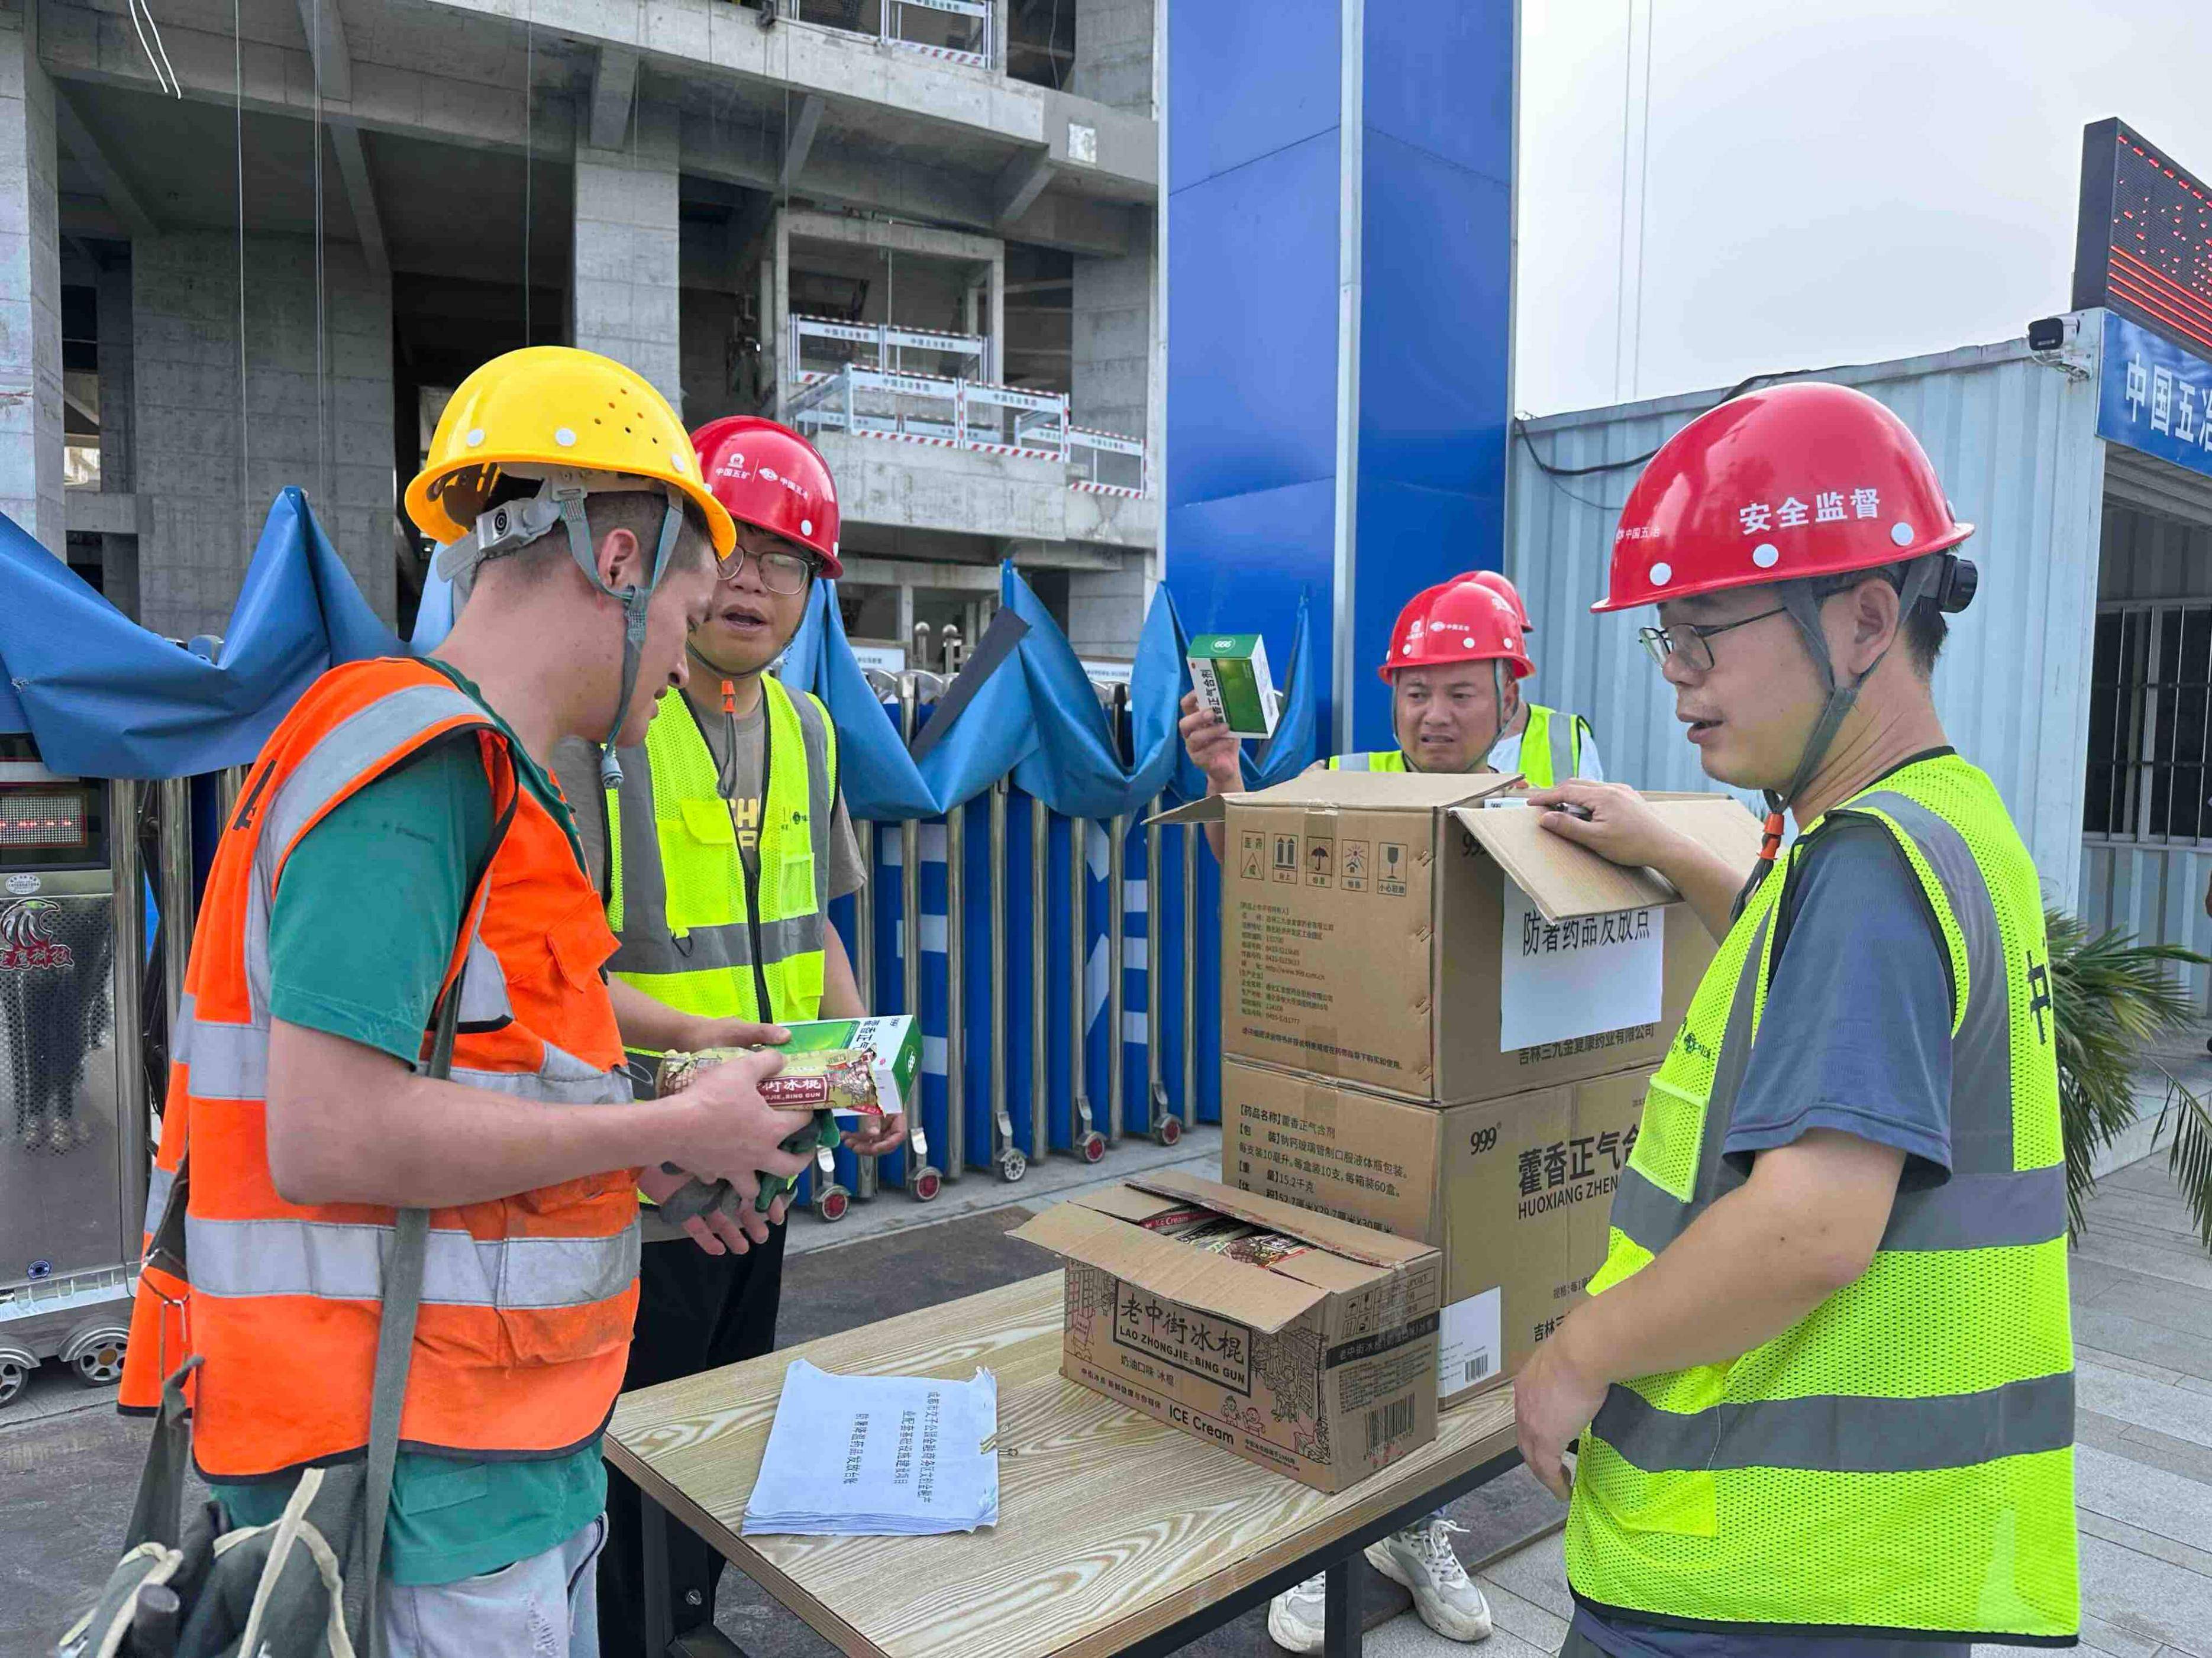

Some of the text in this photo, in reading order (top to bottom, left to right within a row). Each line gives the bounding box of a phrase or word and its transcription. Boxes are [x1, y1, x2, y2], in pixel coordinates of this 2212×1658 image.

[1739, 488, 1881, 535] 安全监督
[758, 1079, 822, 1093] 街冰棍
[1471, 1126, 1498, 1155] 999
[1518, 1174, 1619, 1220] HUOXIANG ZHEN
[1120, 1292, 1245, 1365] 老中街冰棍
[1119, 1324, 1245, 1384] LAO ZHONGJIE BING GUN
[1168, 1404, 1235, 1446] ICE Cream
